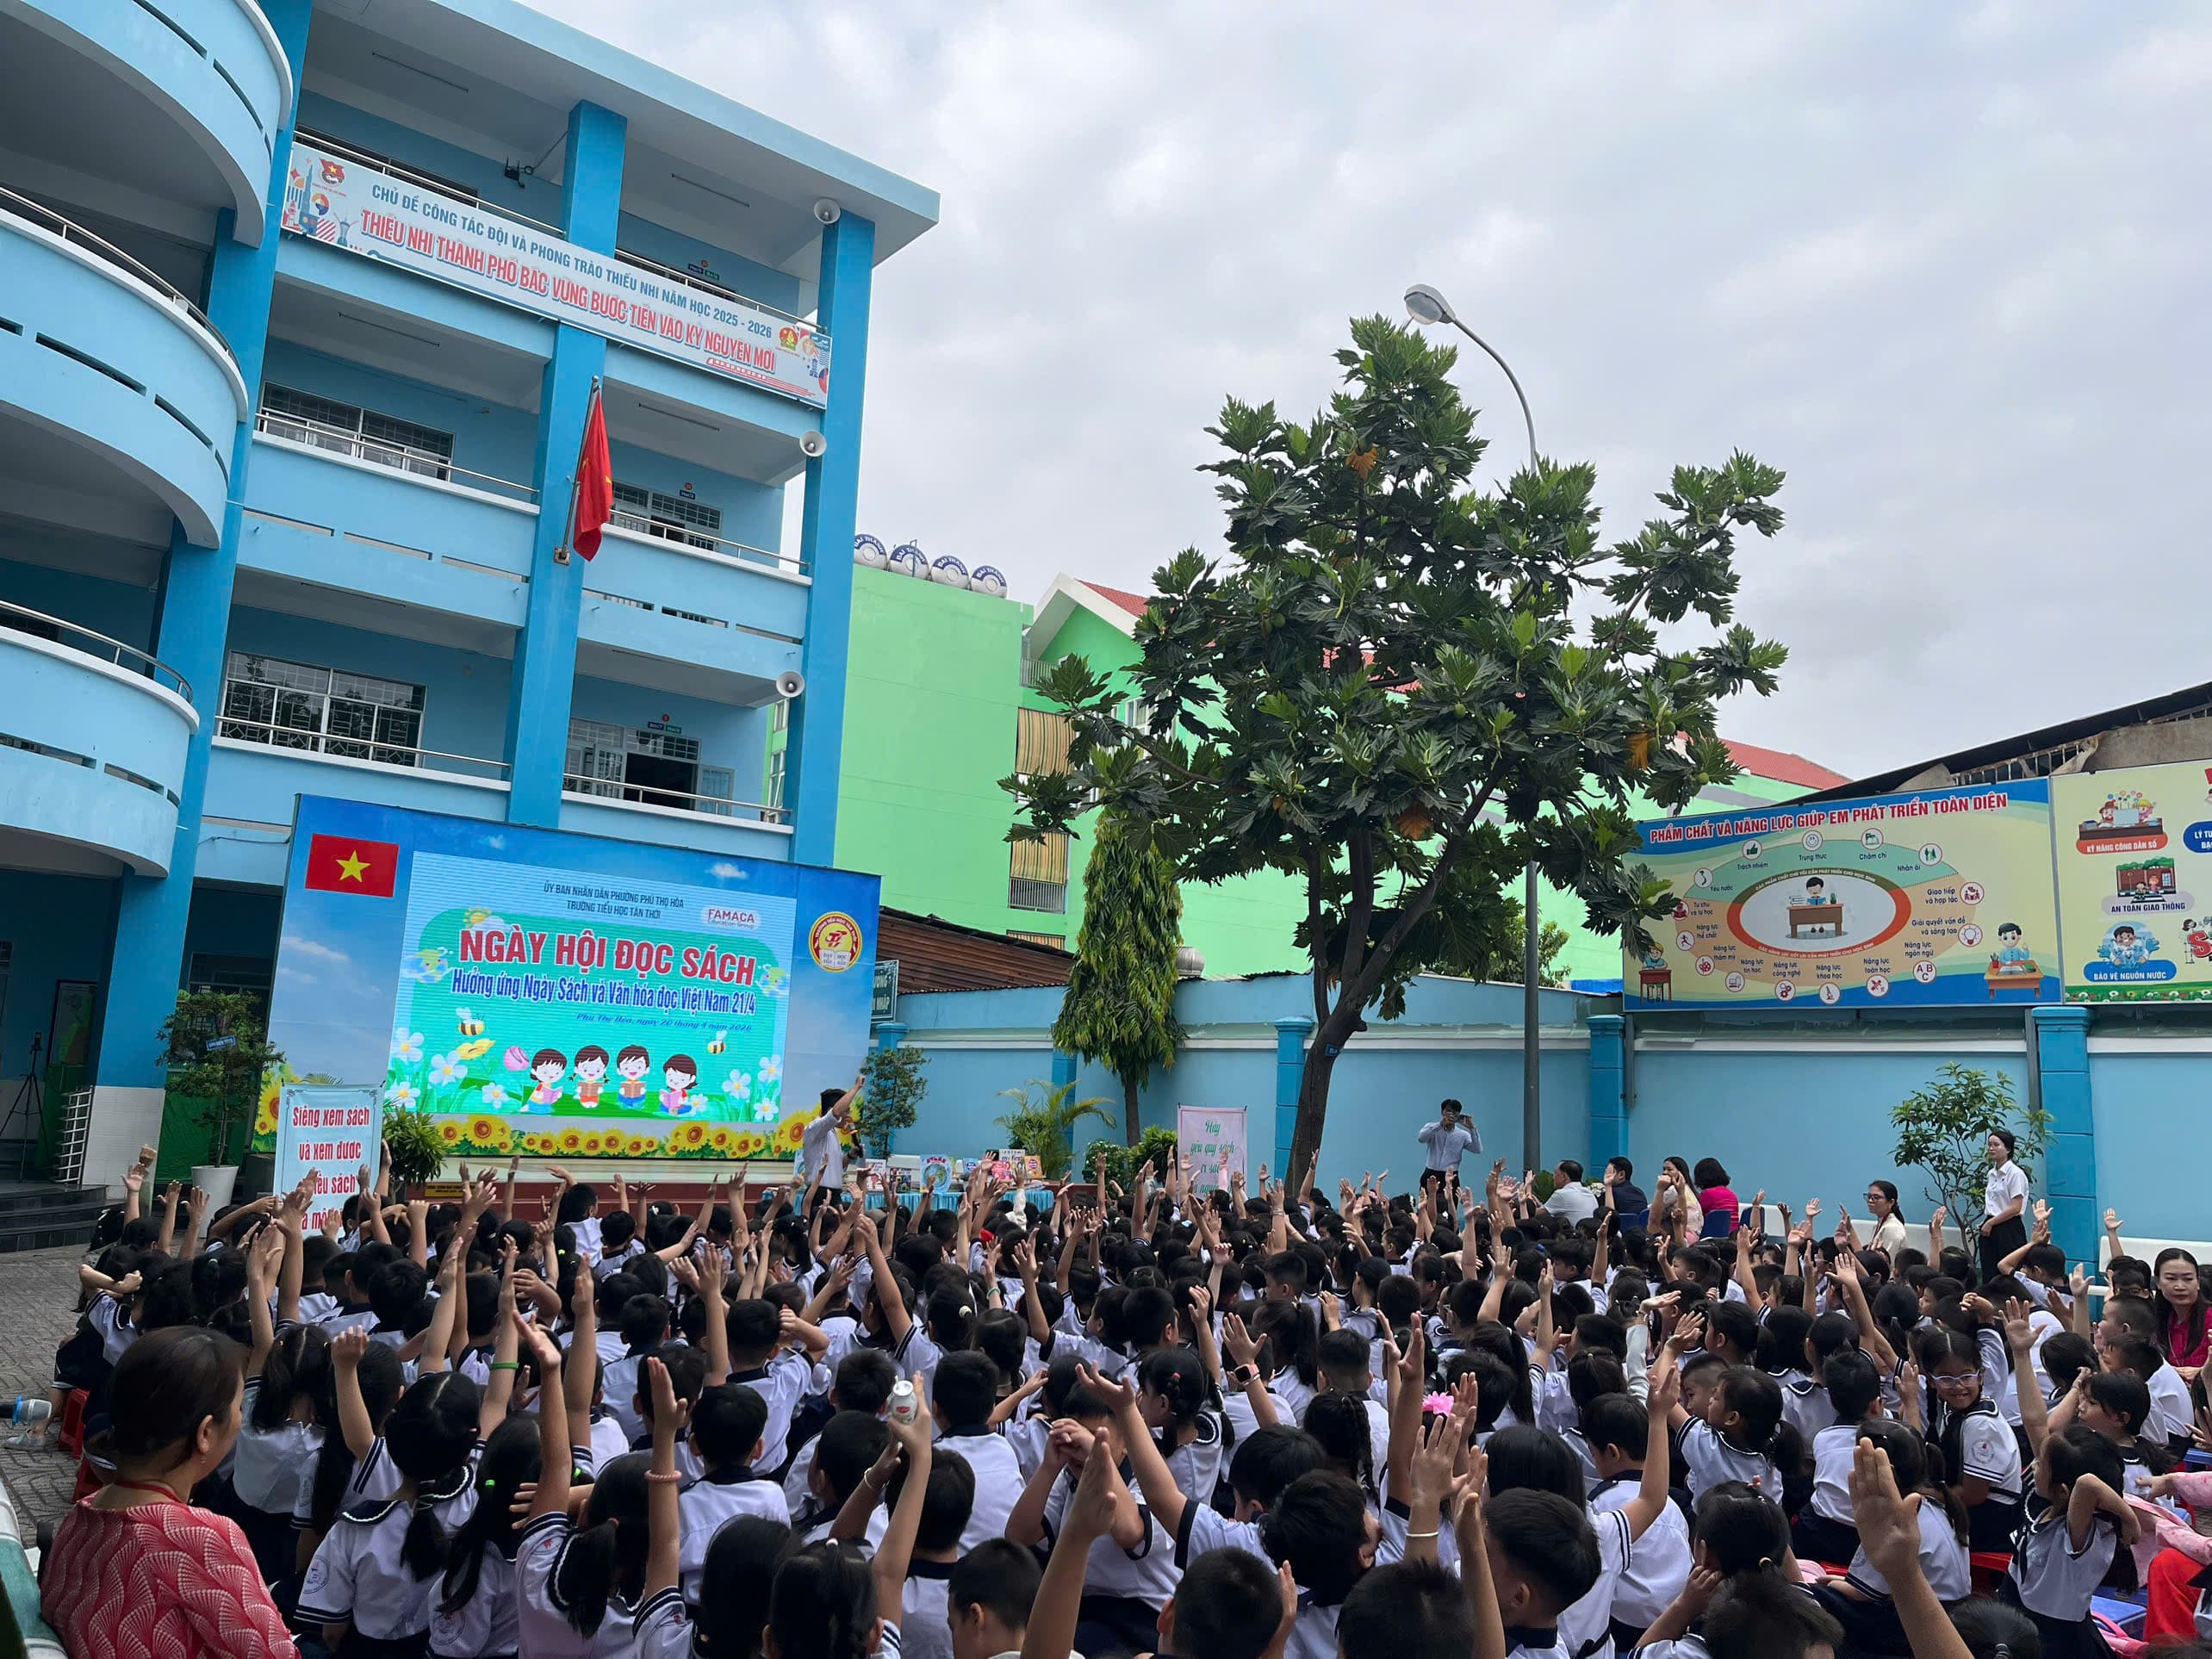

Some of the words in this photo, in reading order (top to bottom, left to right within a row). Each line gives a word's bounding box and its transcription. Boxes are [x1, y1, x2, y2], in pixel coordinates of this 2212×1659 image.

[362, 209, 406, 245] THIẾU
[407, 225, 433, 256] NHI
[437, 236, 485, 271] THÀNH
[372, 184, 398, 205] CHỦ
[401, 195, 419, 212] ĐỀ
[422, 202, 457, 227] CÔNG
[462, 215, 484, 235] TÁC
[488, 226, 508, 246] ĐỘI
[512, 234, 526, 252] VÀ
[530, 241, 570, 267] PHONG
[575, 258, 602, 278] TRÀO
[606, 269, 637, 290] THIẾU
[640, 282, 658, 299] NHI
[662, 289, 687, 308] NĂM
[690, 299, 711, 317] HỌC
[713, 309, 738, 326] 2025
[748, 320, 772, 339] 2026
[1650, 823, 1682, 842] PHẨM
[1686, 819, 1714, 839] CHẤT
[1717, 818, 1731, 836] VÀ
[1735, 817, 1767, 834] NĂNG
[1771, 816, 1793, 832] LỰC
[1798, 811, 1825, 827] GIÚP
[1830, 811, 1849, 824] EM
[1853, 805, 1886, 822] PHÁT
[1889, 798, 1929, 818] TRIỂN
[1933, 796, 1969, 814] TOÀN
[1973, 792, 2008, 812] DIỆN
[2087, 842, 2095, 852] KỸ
[2097, 843, 2114, 852] NĂNG
[2115, 842, 2132, 851] CÔNG
[2134, 842, 2147, 850] DÂN
[2147, 839, 2157, 848] SỐ
[544, 880, 554, 892] ỦY
[556, 885, 570, 895] BAN
[572, 886, 593, 898] NHÂN
[594, 888, 609, 899] DÂN
[611, 891, 638, 903] PHƯỜNG
[640, 893, 654, 904] PHÚ
[656, 897, 668, 908] THỌ
[671, 898, 684, 908] HÒA
[1943, 886, 1955, 896] tiếp
[566, 899, 595, 912] TRƯỜNG
[597, 901, 612, 914] TIỂU
[614, 906, 628, 916] HỌC
[630, 907, 643, 917] TÂN
[2122, 903, 2141, 911] TOÀN
[2162, 902, 2185, 910] THÔNG
[708, 909, 755, 923] FAMACA
[1925, 916, 1942, 927] quyết
[1945, 916, 1956, 924] vấn
[1930, 927, 1945, 935] sáng
[1904, 941, 1920, 950] Năng
[460, 925, 547, 963] NGÀY
[555, 929, 606, 973] HỘI
[614, 939, 674, 978] ĐỌC
[680, 945, 755, 986] SÁCH
[1863, 957, 1880, 966] Năng
[2094, 972, 2108, 980] BẢO
[2110, 971, 2119, 981] VỆ
[2121, 971, 2145, 979] NGUỒN
[2147, 970, 2166, 979] NƯỚC
[452, 967, 494, 997] Hưởng
[497, 972, 520, 1000] ứng
[524, 974, 555, 1002] Ngày
[558, 976, 588, 1003] Sách
[592, 979, 605, 1003] và
[608, 981, 629, 1005] Văn
[633, 983, 654, 1007] hóa
[657, 985, 677, 1014] đọc
[680, 986, 703, 1015] Việt
[705, 990, 730, 1012] Nam
[731, 991, 757, 1015] 21/4
[293, 1105, 320, 1128] Siêng
[322, 1109, 345, 1127] xem
[347, 1105, 370, 1126] sách
[299, 1140, 310, 1160] và
[314, 1142, 334, 1160] xem
[336, 1140, 362, 1163] được
[1190, 1140, 1202, 1155] yêu
[331, 1174, 356, 1194] sách
